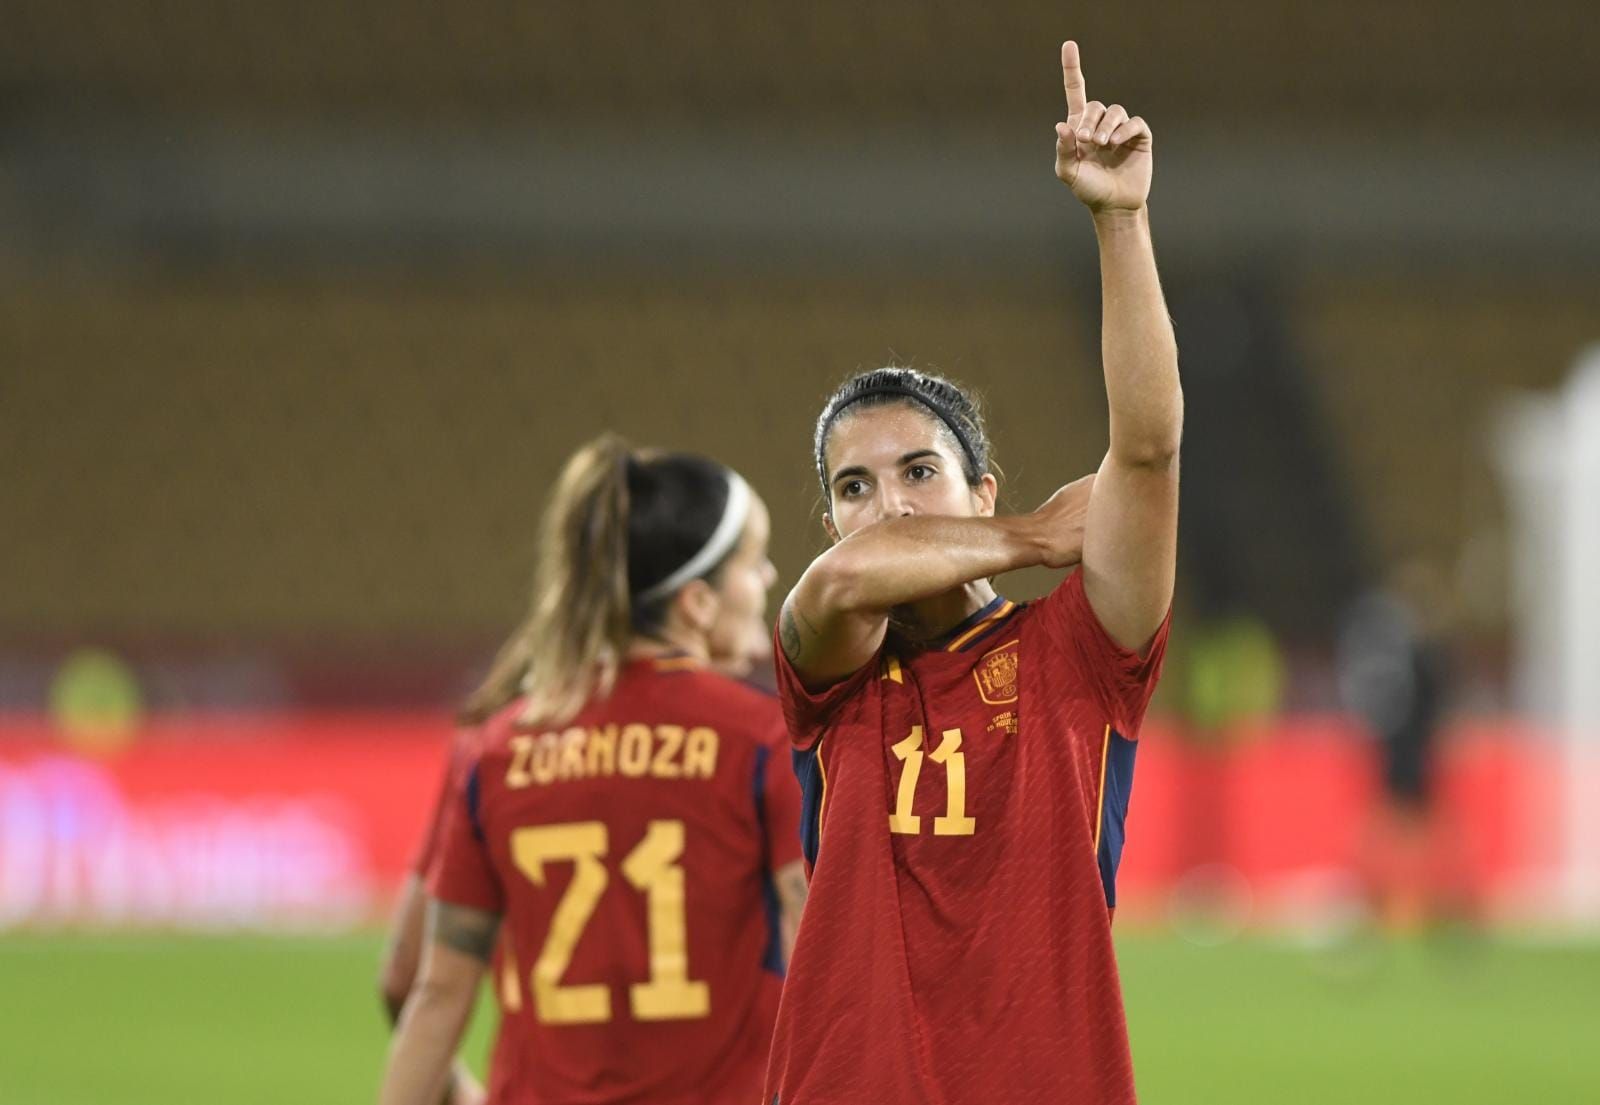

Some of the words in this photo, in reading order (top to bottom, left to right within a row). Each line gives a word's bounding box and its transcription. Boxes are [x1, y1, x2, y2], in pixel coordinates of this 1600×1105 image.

[505, 723, 720, 789] ZORNOZA
[889, 725, 976, 835] 11
[510, 819, 711, 1025] 21
